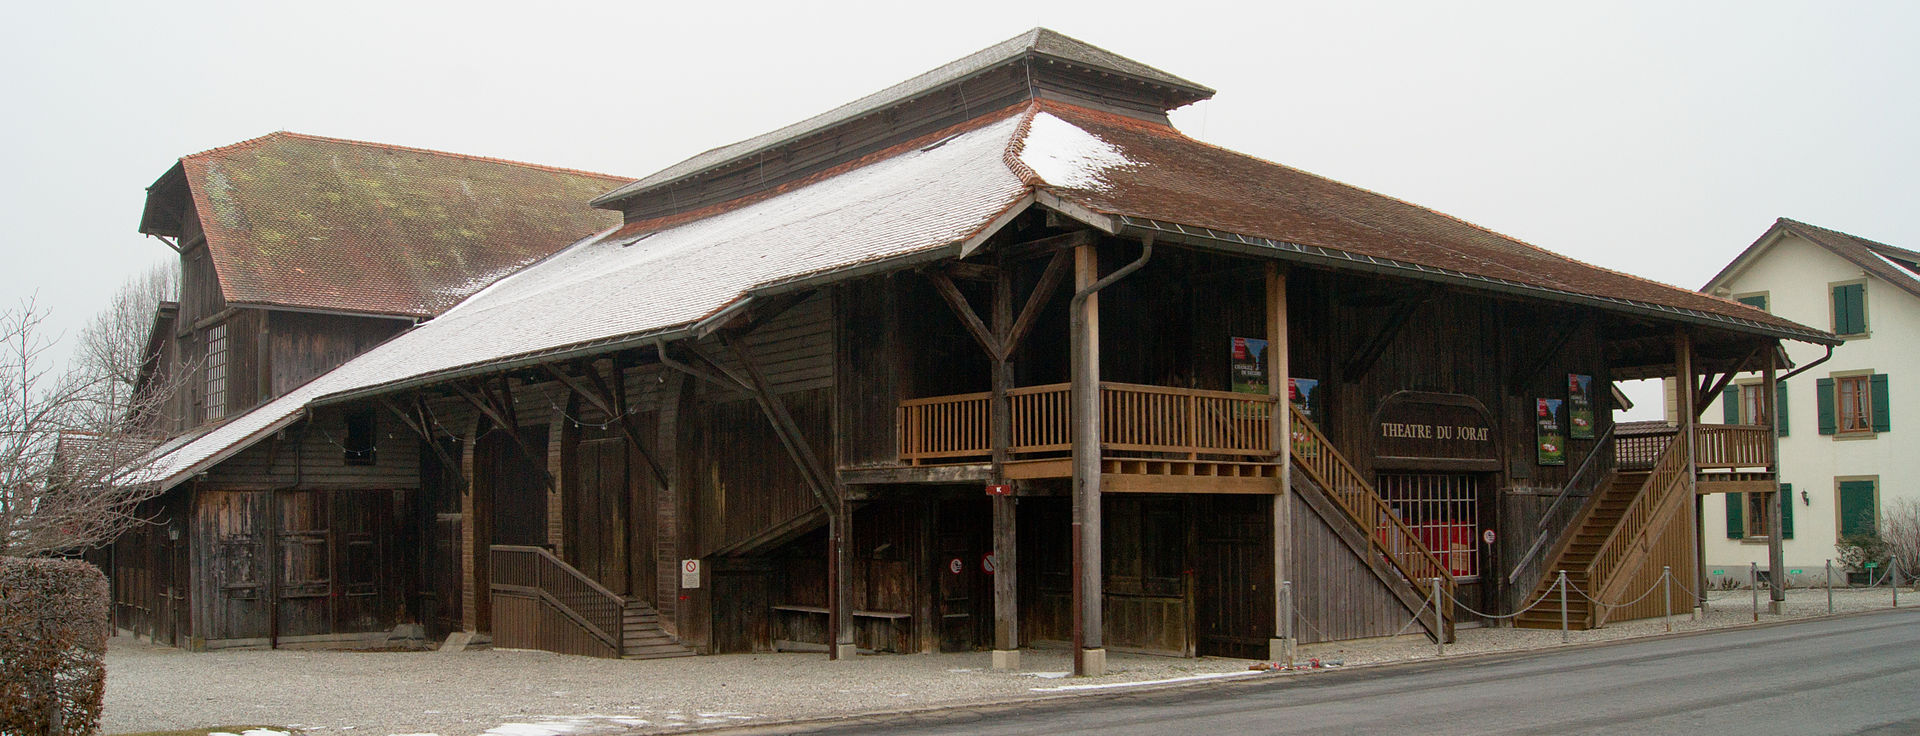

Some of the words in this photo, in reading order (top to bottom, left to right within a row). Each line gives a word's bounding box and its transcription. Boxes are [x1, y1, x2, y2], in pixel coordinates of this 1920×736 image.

[1381, 422, 1432, 439] THEATRE
[1437, 425, 1452, 440] DU
[1456, 426, 1489, 441] JORAT
